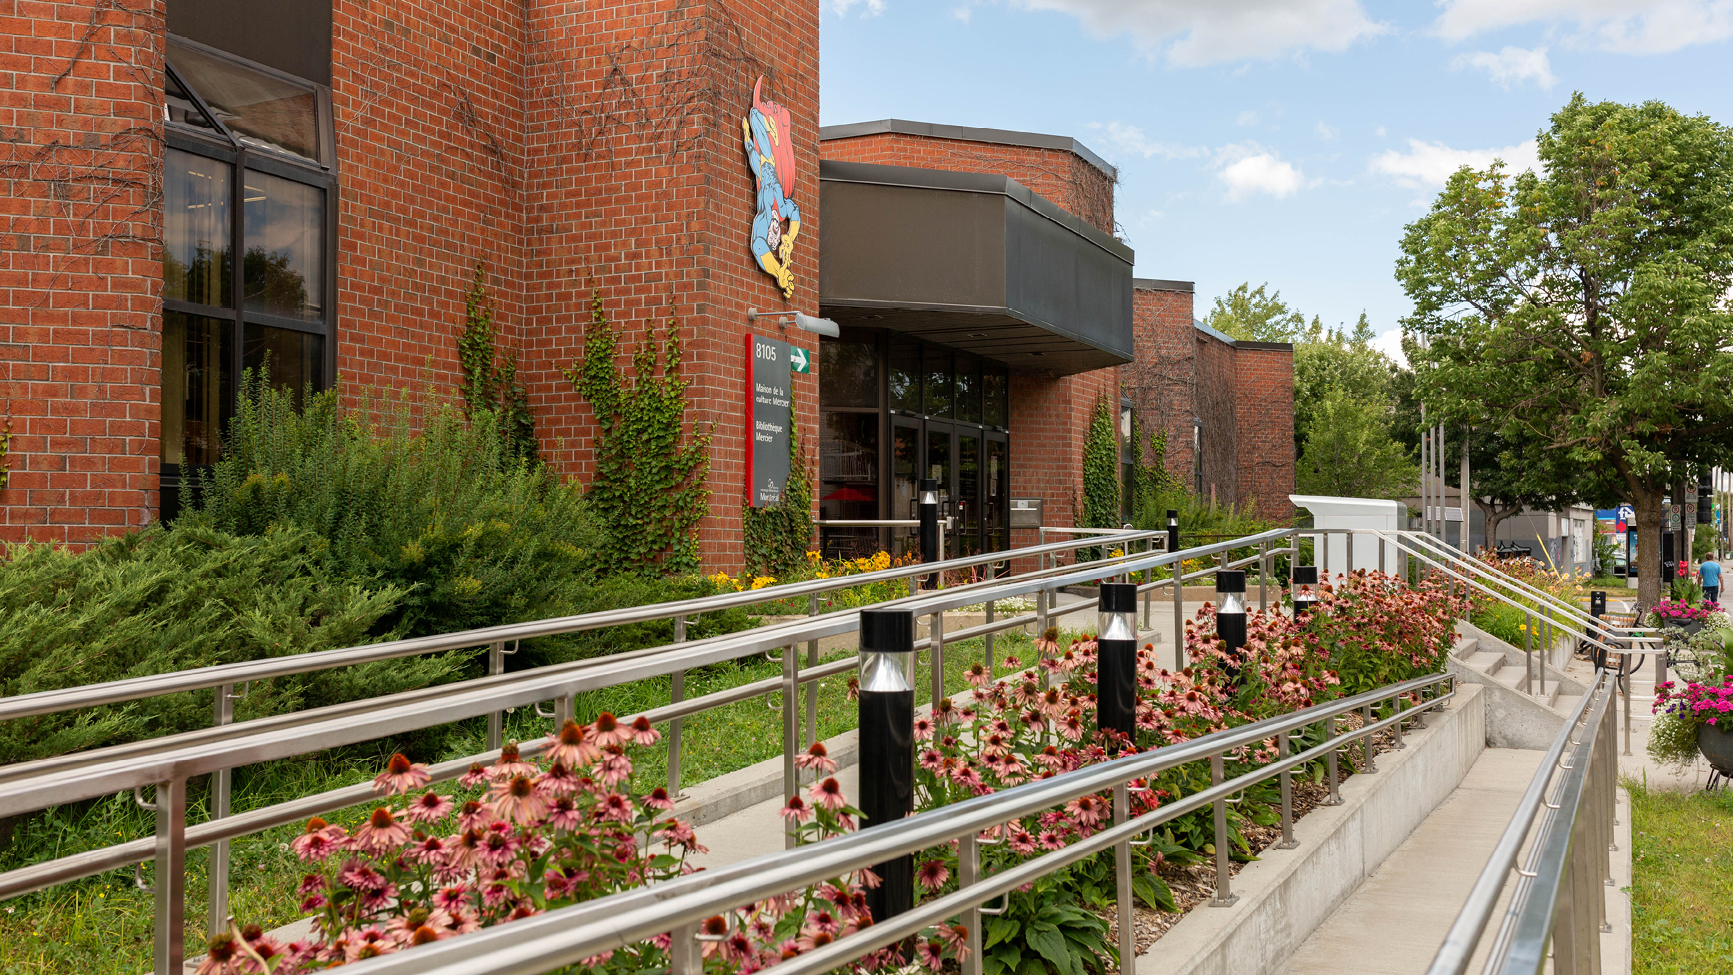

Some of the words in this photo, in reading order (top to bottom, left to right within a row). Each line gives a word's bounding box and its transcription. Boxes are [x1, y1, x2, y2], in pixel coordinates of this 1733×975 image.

[756, 343, 776, 361] 8105
[756, 383, 772, 394] Maison
[773, 386, 779, 396] de
[779, 387, 784, 396] la
[756, 396, 772, 405] culture
[773, 397, 789, 407] Mercier
[756, 421, 783, 434] Bibliothèque
[756, 432, 773, 443] Mercier
